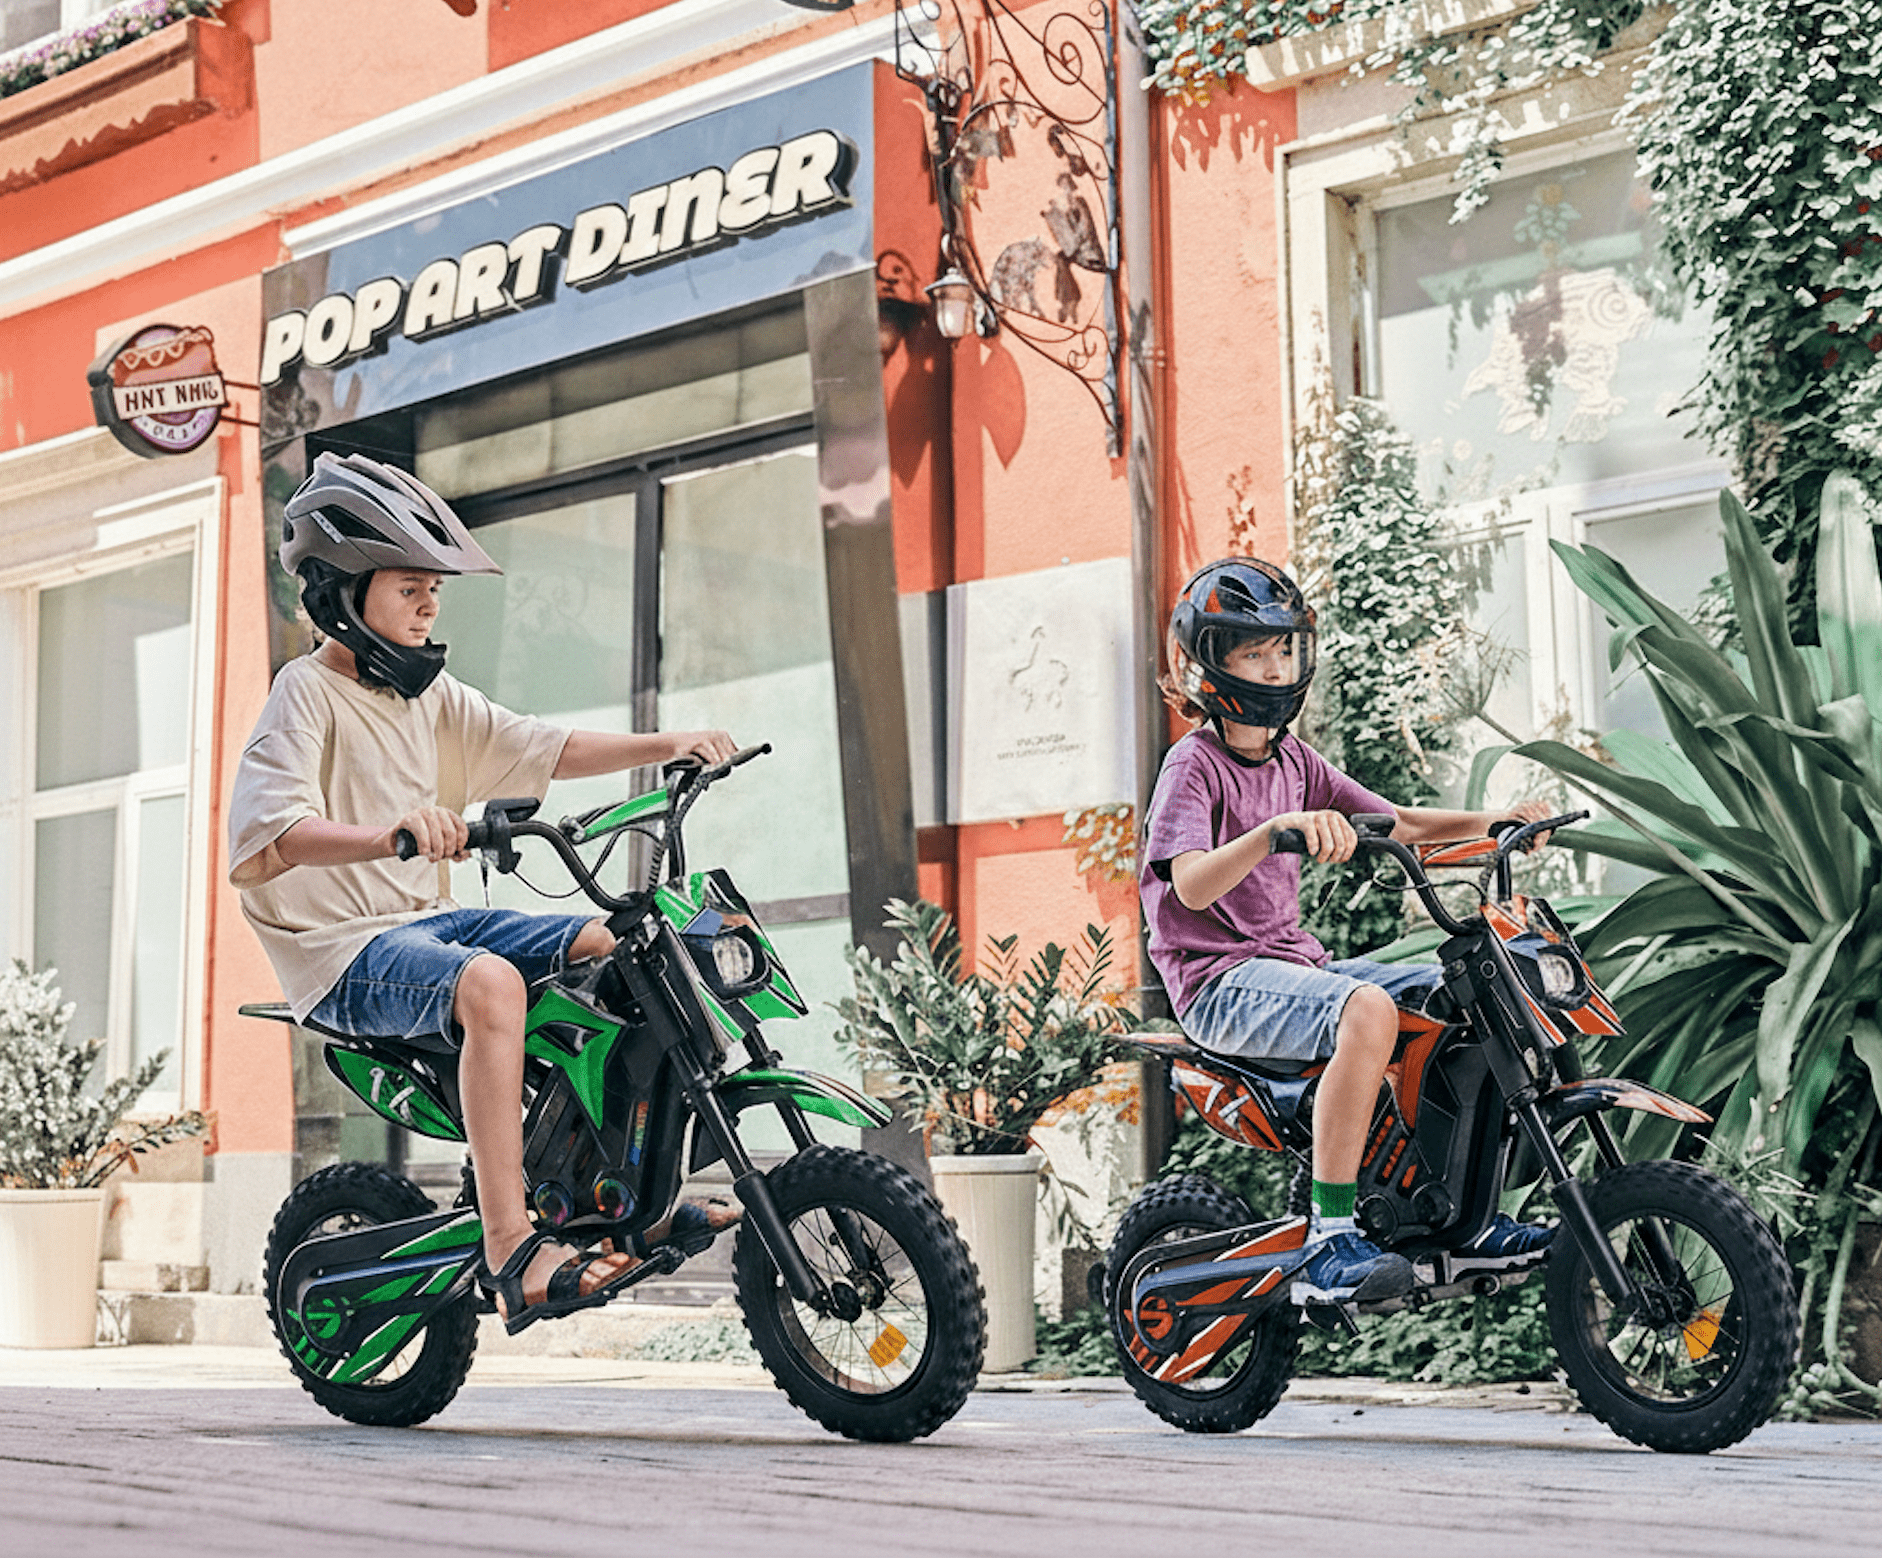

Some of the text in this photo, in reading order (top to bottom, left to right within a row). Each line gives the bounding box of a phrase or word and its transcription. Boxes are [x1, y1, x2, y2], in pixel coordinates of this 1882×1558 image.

[260, 128, 842, 386] POP ART DINER
